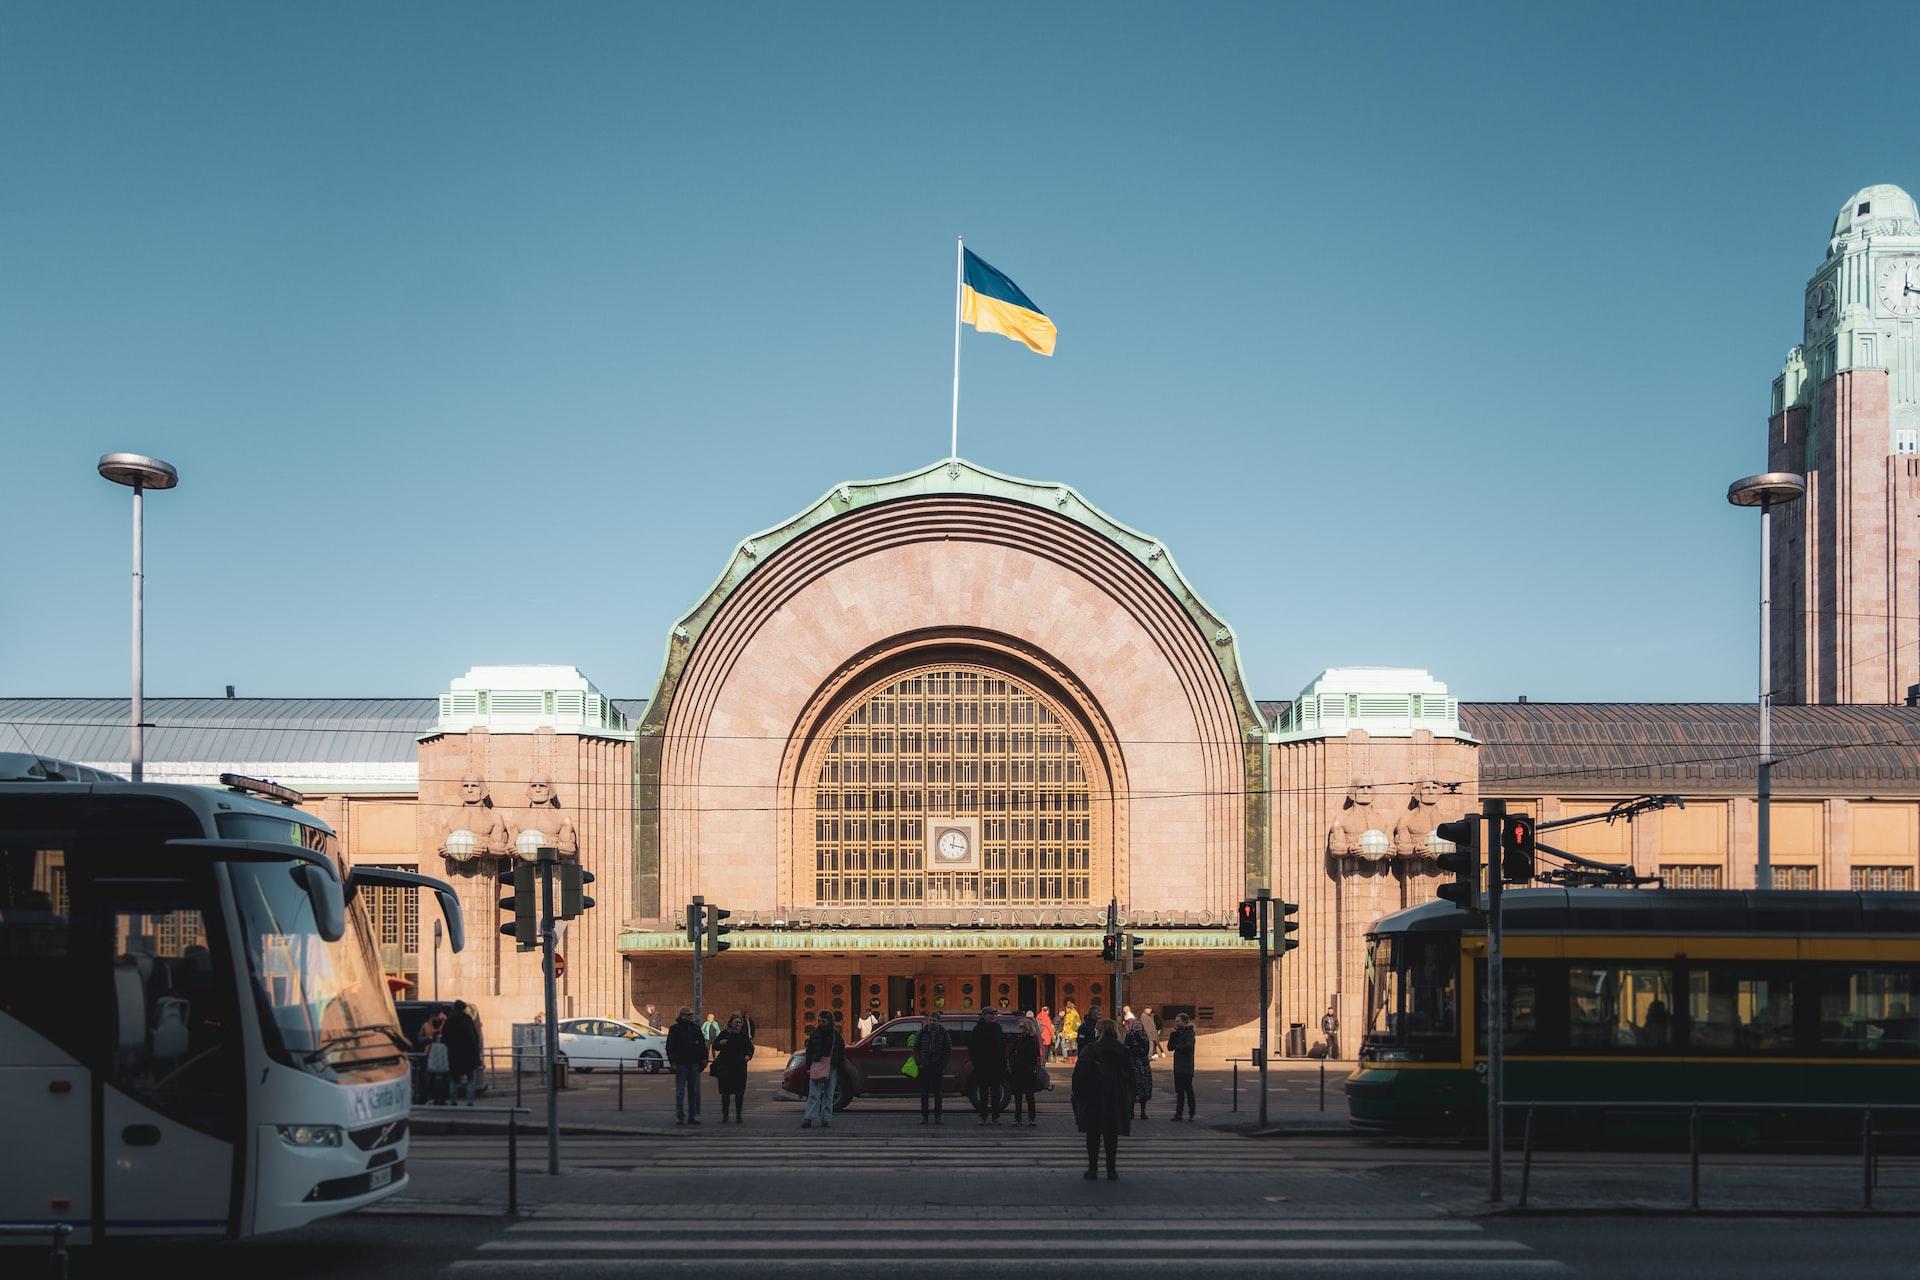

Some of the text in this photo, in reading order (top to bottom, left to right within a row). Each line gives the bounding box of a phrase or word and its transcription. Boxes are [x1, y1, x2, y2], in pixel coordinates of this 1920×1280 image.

[674, 907, 1235, 928] RTATIEASEMA JÄRNVÄGSSTATION
[1592, 970, 1607, 994] 7
[261, 1067, 270, 1085] 1
